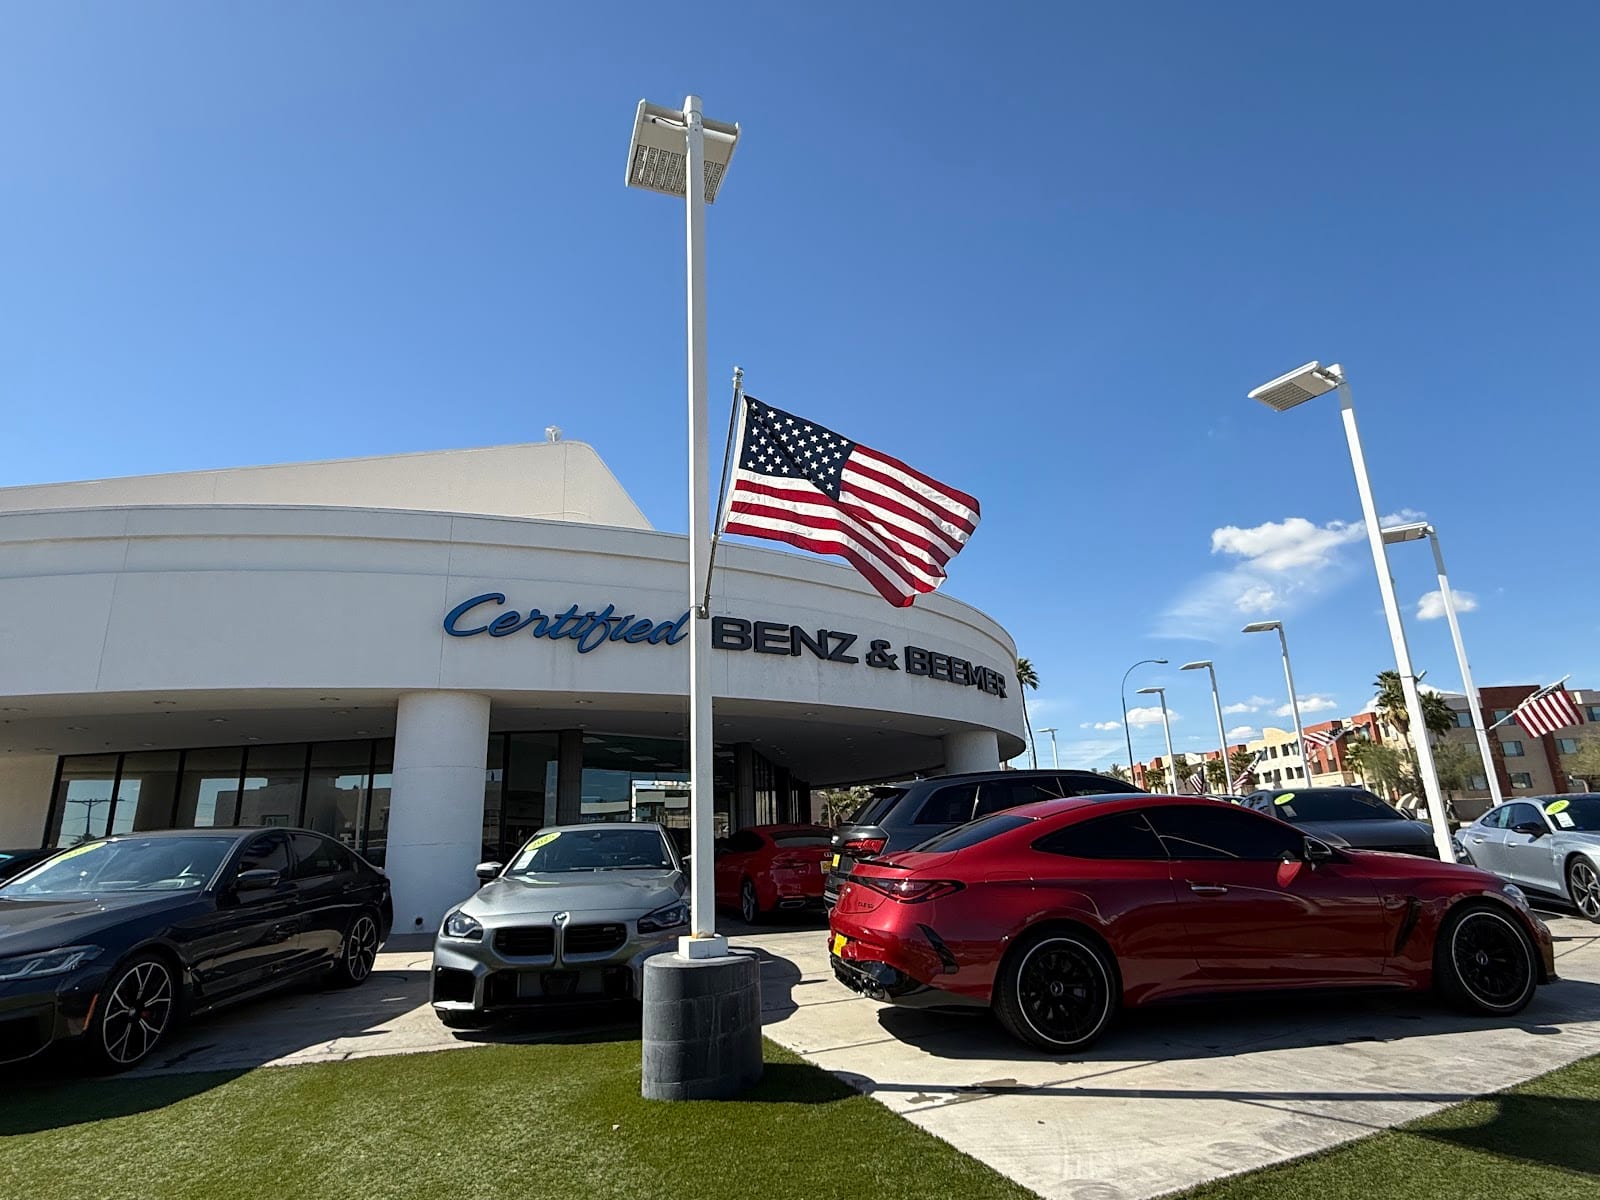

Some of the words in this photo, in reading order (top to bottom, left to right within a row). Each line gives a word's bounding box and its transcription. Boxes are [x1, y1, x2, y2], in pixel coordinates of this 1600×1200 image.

[444, 592, 689, 654] Certified
[711, 616, 859, 664] BENZ
[866, 639, 901, 670] &
[904, 645, 1008, 698] BEEMER
